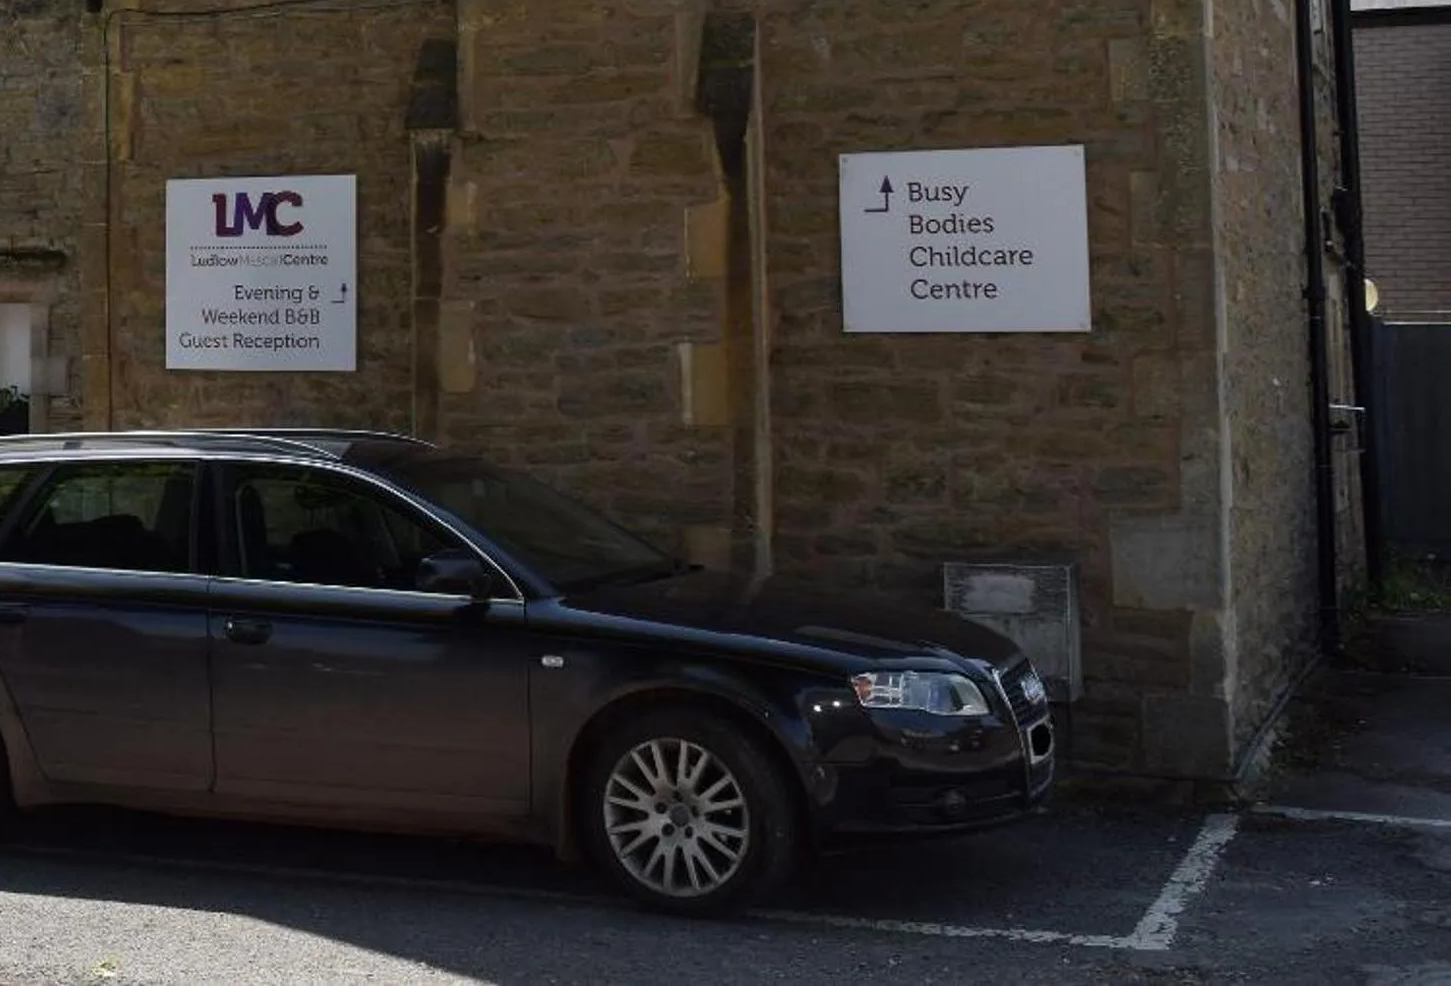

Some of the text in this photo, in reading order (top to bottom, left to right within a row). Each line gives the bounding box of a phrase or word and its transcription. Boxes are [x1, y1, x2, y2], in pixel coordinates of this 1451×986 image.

[907, 182, 968, 206] Busy
[212, 191, 304, 237] LMC
[909, 214, 995, 234] Bodies
[909, 246, 1034, 267] Childcare
[234, 285, 320, 304] Evening &
[910, 279, 998, 300] Centre
[202, 309, 320, 325] Weekend B&B
[179, 332, 320, 352] Guest Reception
